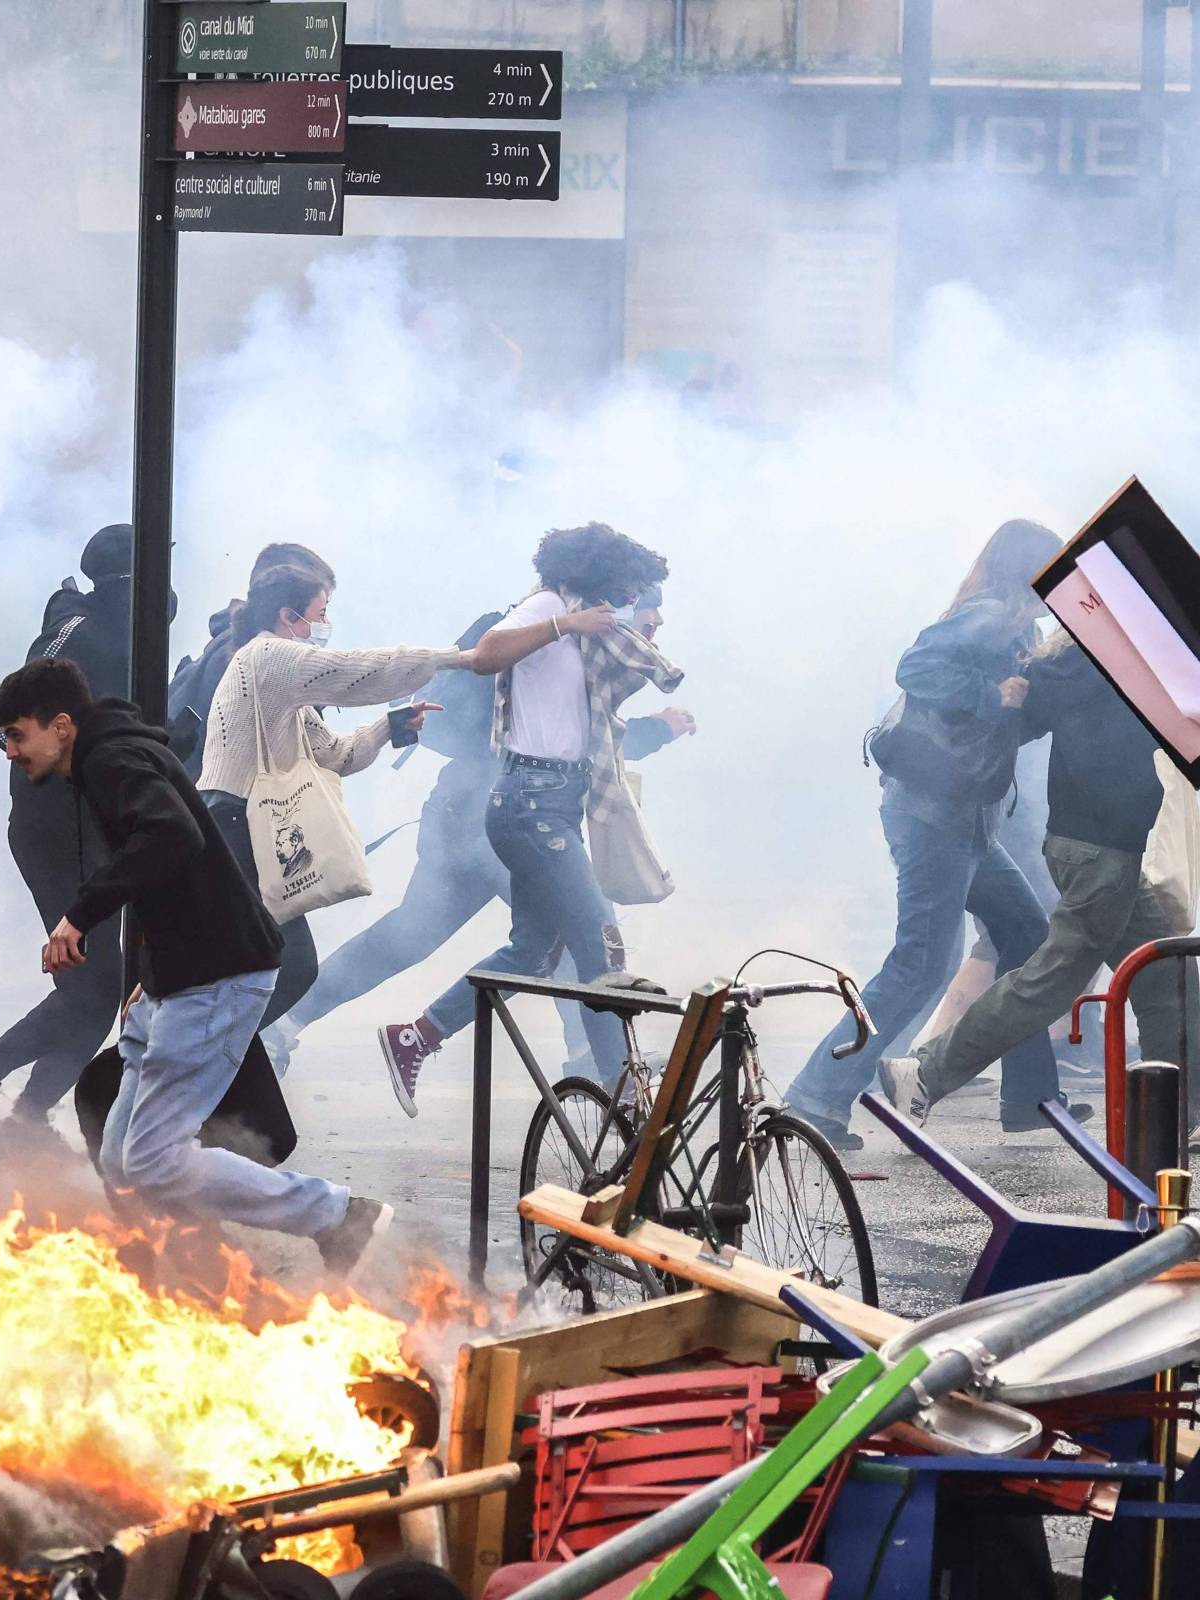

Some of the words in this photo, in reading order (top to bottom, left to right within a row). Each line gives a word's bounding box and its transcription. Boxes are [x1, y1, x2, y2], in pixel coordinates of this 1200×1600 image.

[200, 16, 222, 36] canal
[224, 16, 235, 36] du
[237, 15, 254, 36] Midi
[305, 16, 314, 29] 10
[316, 16, 328, 29] min
[211, 48, 225, 60] verte
[226, 47, 233, 60] du
[234, 47, 249, 60] canal
[305, 46, 319, 60] 670
[320, 48, 327, 60] m
[493, 63, 502, 76] 4
[506, 63, 532, 77] min
[349, 69, 455, 95] publiques
[307, 94, 316, 108] 12
[317, 94, 331, 108] min
[488, 92, 514, 106] 270
[519, 95, 532, 106] m
[199, 105, 239, 125] Matabiau
[241, 108, 266, 129] gares
[307, 124, 321, 138] 800
[322, 127, 330, 138] m
[490, 143, 499, 156] 3
[504, 143, 529, 157] min
[345, 169, 381, 184] itanie
[485, 172, 511, 186] 190
[515, 175, 529, 186] m
[175, 177, 204, 194] centre
[205, 174, 232, 195] social
[233, 179, 244, 195] et
[245, 175, 281, 195] culturel
[307, 177, 313, 191] 6
[314, 177, 327, 191] min
[174, 205, 204, 221] Raymond
[204, 206, 212, 219] IV
[304, 208, 317, 222] 370
[318, 210, 327, 222] m
